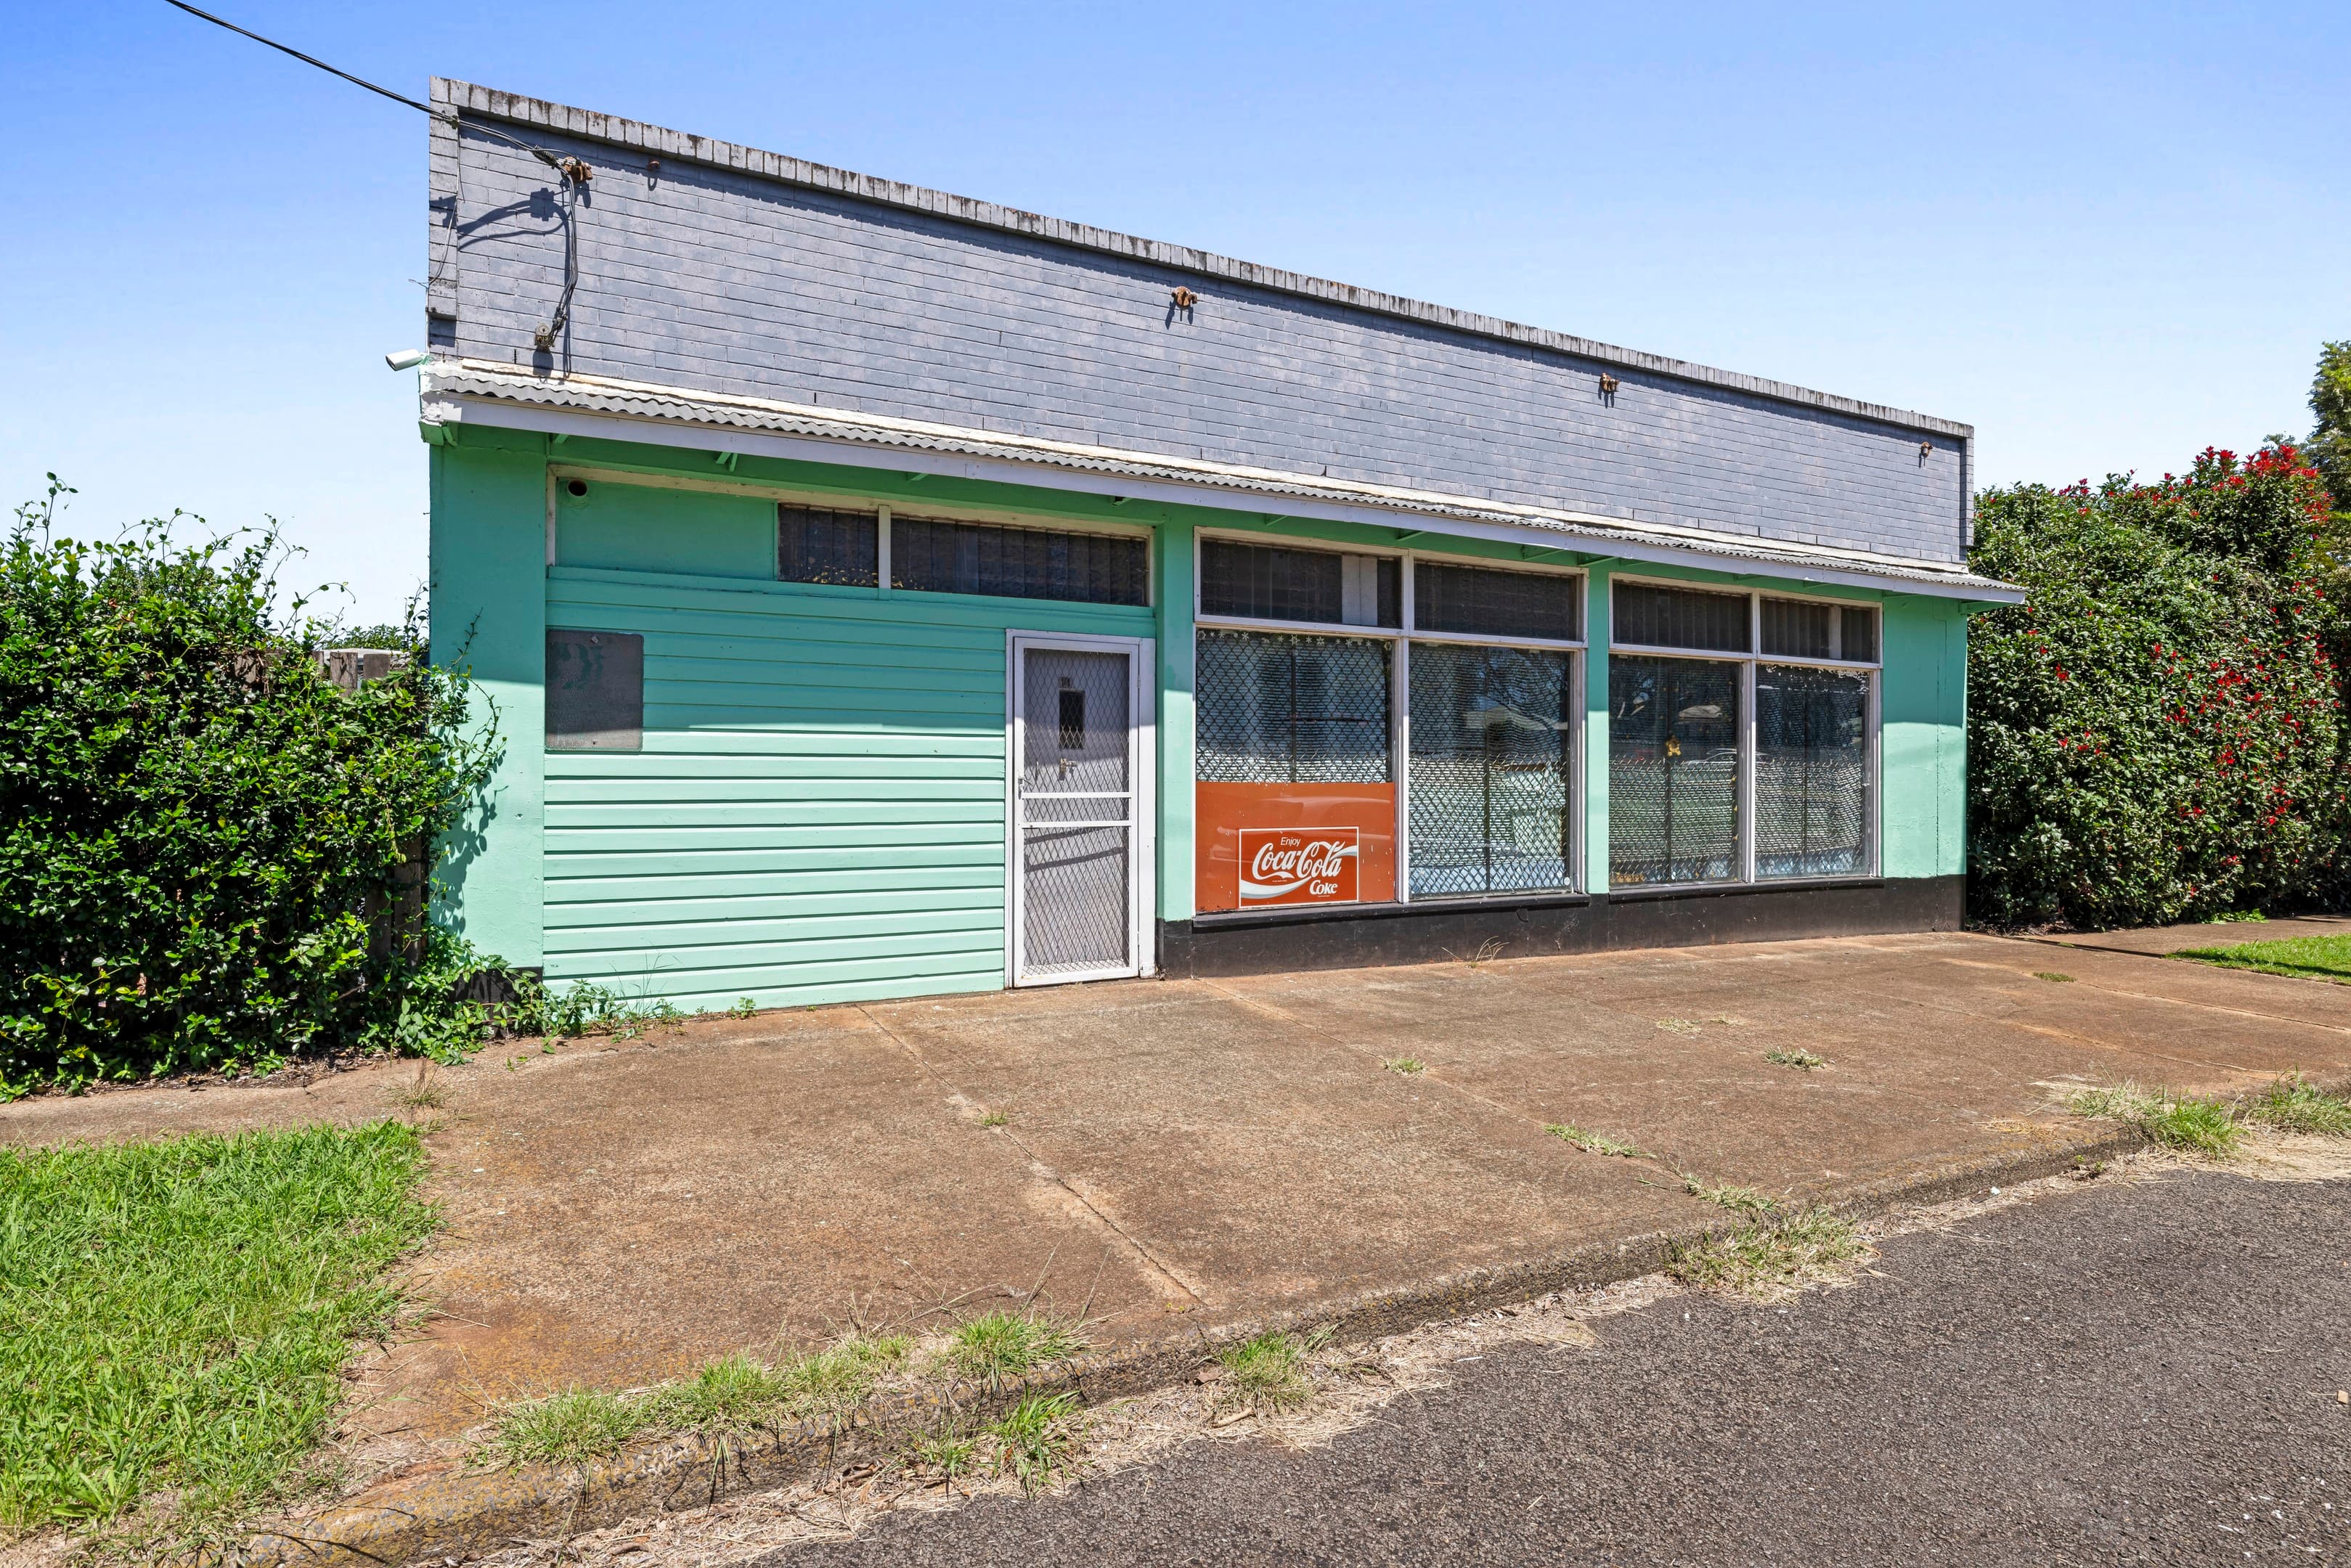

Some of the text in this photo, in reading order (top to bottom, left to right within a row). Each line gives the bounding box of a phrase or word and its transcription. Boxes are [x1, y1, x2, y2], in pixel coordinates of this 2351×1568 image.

[1280, 837, 1301, 846] Enjoy
[1252, 841, 1345, 881] Coca-Cola
[1309, 879, 1338, 895] Coke
